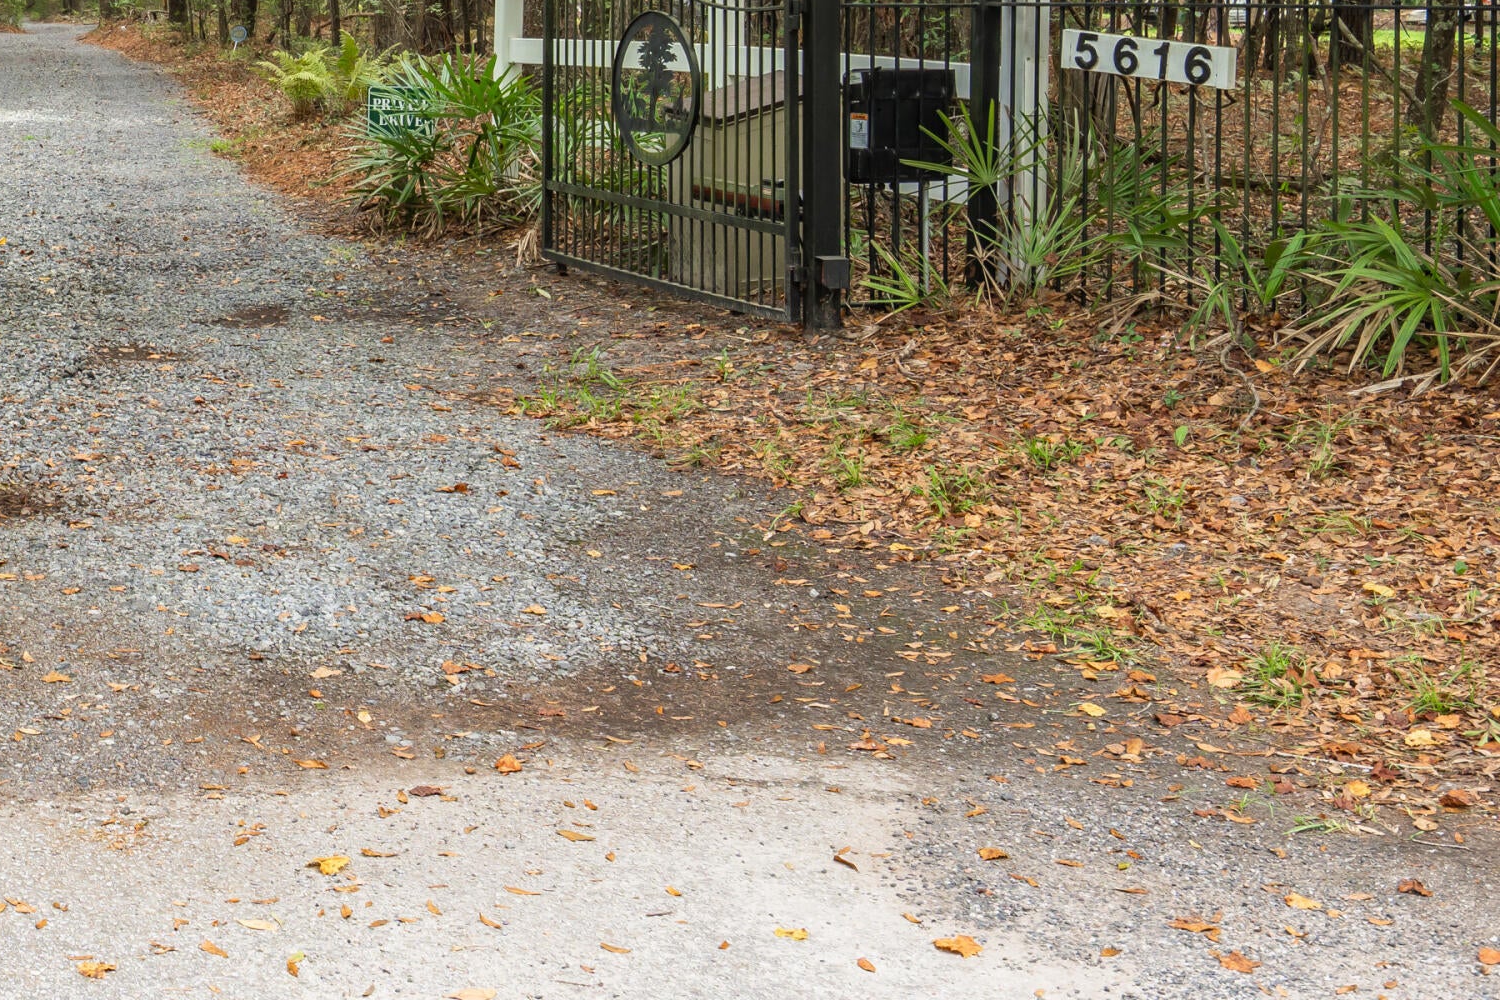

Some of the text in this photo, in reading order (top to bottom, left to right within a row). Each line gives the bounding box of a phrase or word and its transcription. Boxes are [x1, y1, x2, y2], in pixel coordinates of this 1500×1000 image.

[1075, 33, 1212, 84] 5616
[373, 98, 428, 110] PRIV
[379, 113, 423, 126] DRIVE
